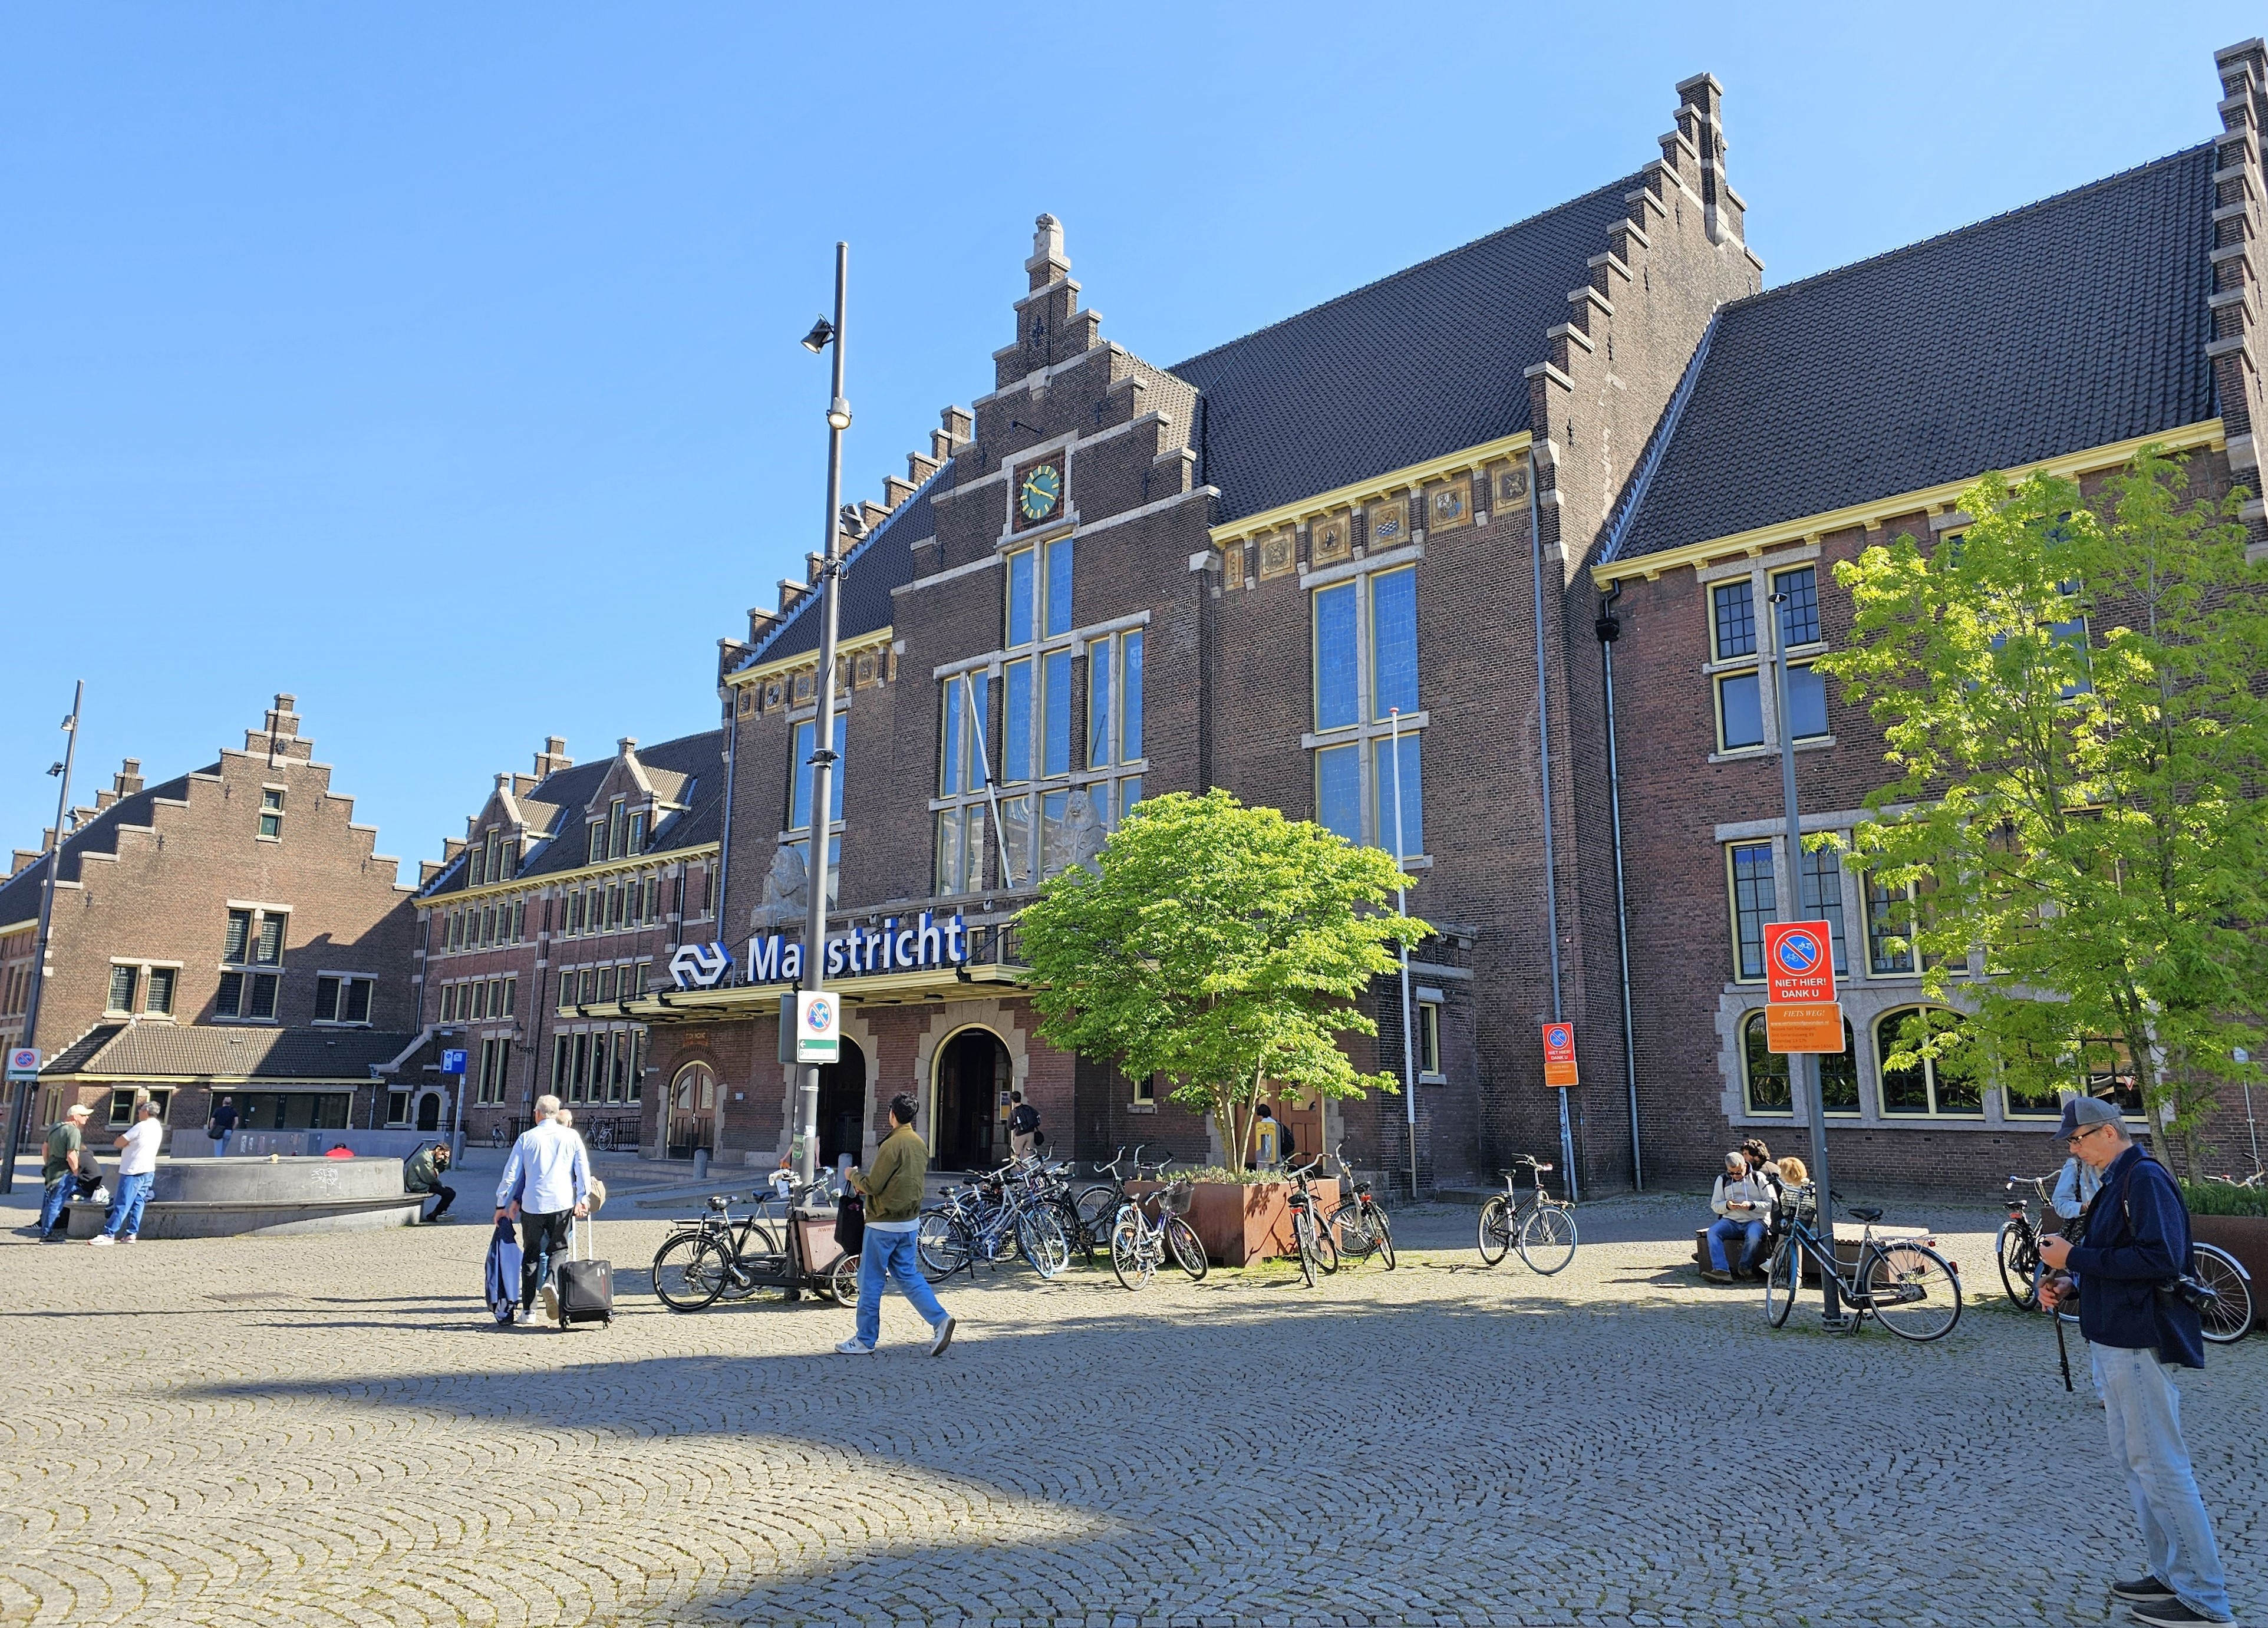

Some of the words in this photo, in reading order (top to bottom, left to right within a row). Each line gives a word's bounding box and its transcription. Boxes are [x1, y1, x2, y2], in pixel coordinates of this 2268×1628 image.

[747, 912, 967, 983] Mastricht
[1775, 979, 1797, 987] NIET
[1800, 978, 1827, 986] HIER!
[1782, 990, 1809, 998] DANK
